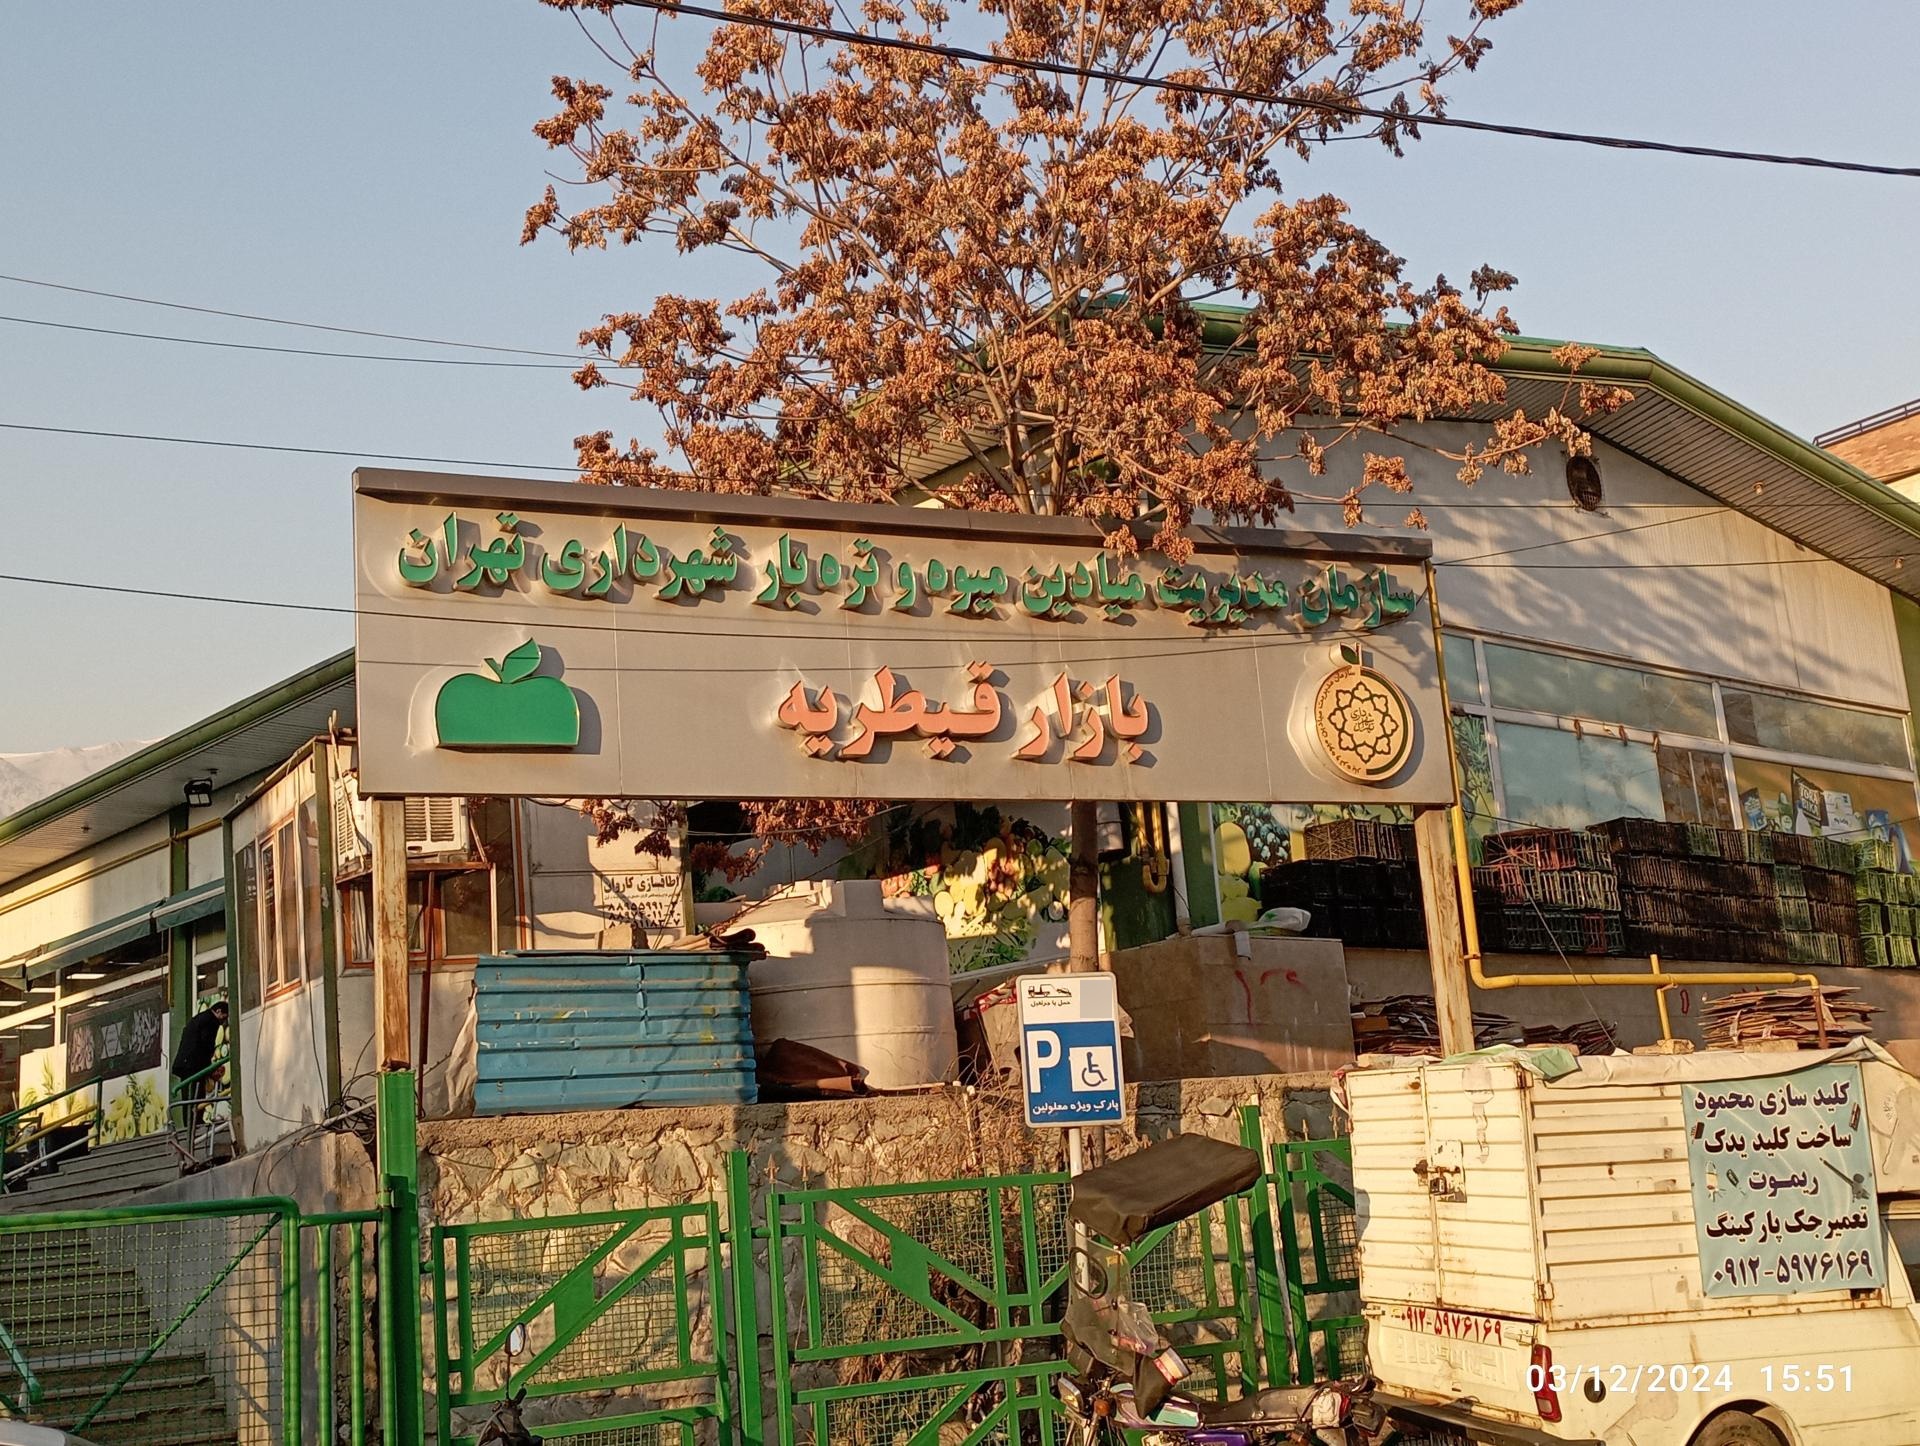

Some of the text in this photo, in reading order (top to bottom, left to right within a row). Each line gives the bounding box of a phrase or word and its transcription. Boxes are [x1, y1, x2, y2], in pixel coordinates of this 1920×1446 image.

[397, 510, 1417, 628] سازمان مدیریت میادین میوه و تره بار شهرداری تهران
[776, 660, 1150, 766] بازار قیطریه
[1027, 1030, 1061, 1093] P
[1032, 1102, 1068, 1115] معلولین
[1070, 1101, 1092, 1113] ویژه
[1694, 1091, 1755, 1118] محمود
[1759, 1084, 1807, 1116] سازی
[1813, 1082, 1850, 1112] کلید
[1704, 1124, 1852, 1158] ساخت کلید یدک
[1749, 1170, 1819, 1197] ریموت
[1784, 1209, 1822, 1239] جک
[1824, 1206, 1869, 1239] تعمیر
[1713, 1250, 1874, 1287] ۰۹۱۲-۵۹۷۶۱۶۹
